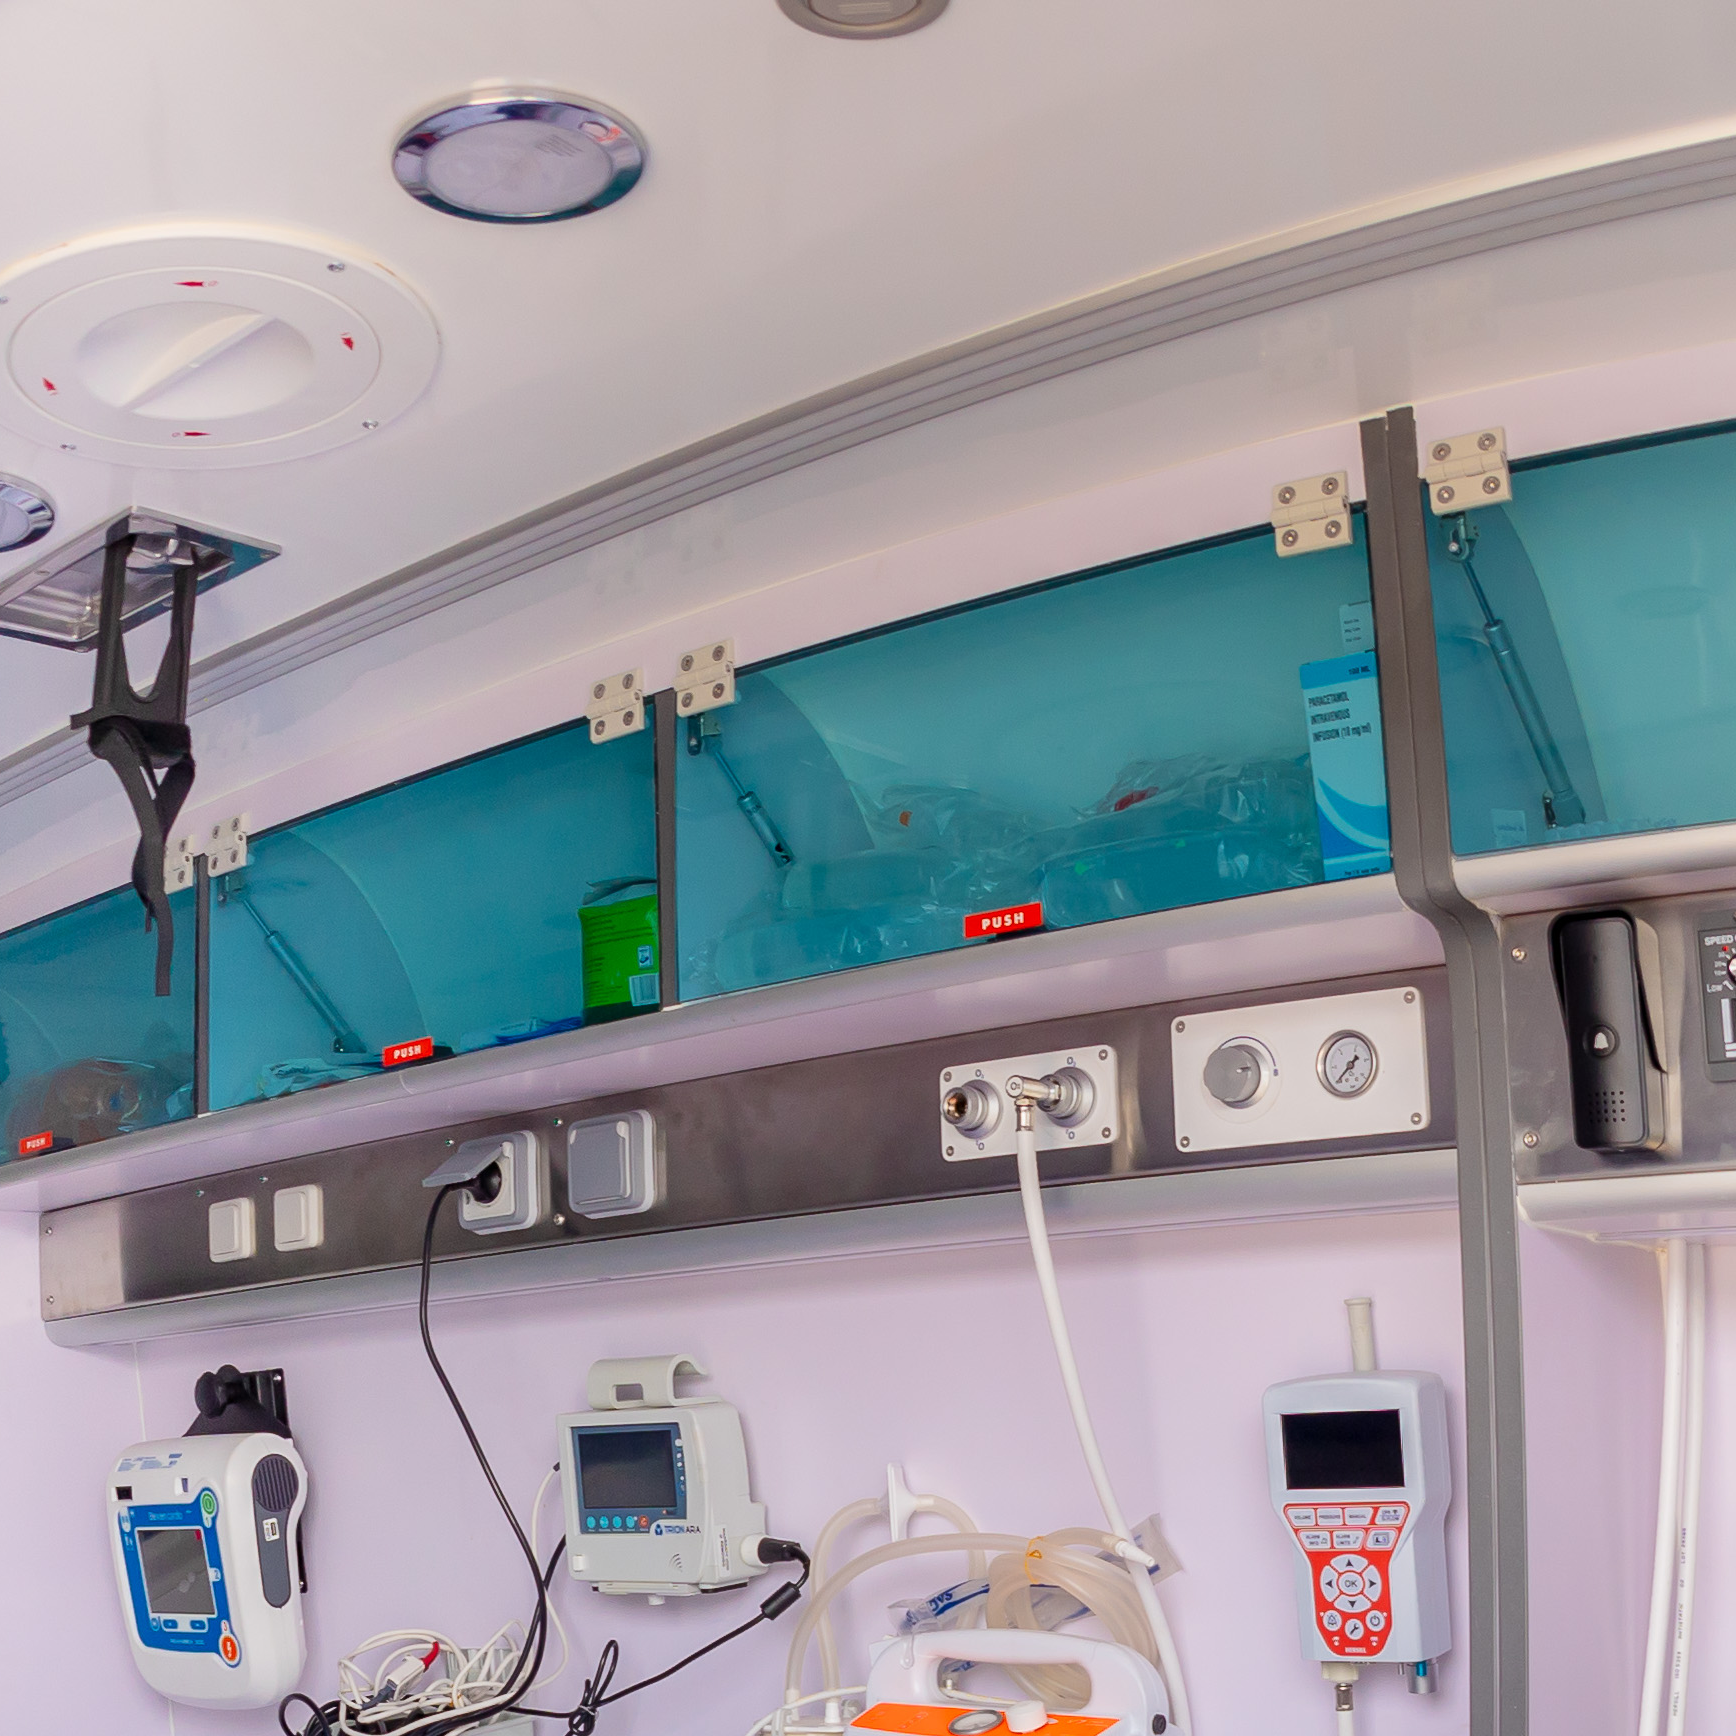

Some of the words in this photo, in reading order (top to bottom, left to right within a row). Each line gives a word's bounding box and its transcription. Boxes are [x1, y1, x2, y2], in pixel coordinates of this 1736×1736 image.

[981, 911, 1024, 930] PUSH
[1704, 934, 1734, 946] SPEED
[1706, 983, 1723, 993] Low
[393, 1044, 421, 1060] PUSH
[1344, 1580, 1358, 1588] OK
